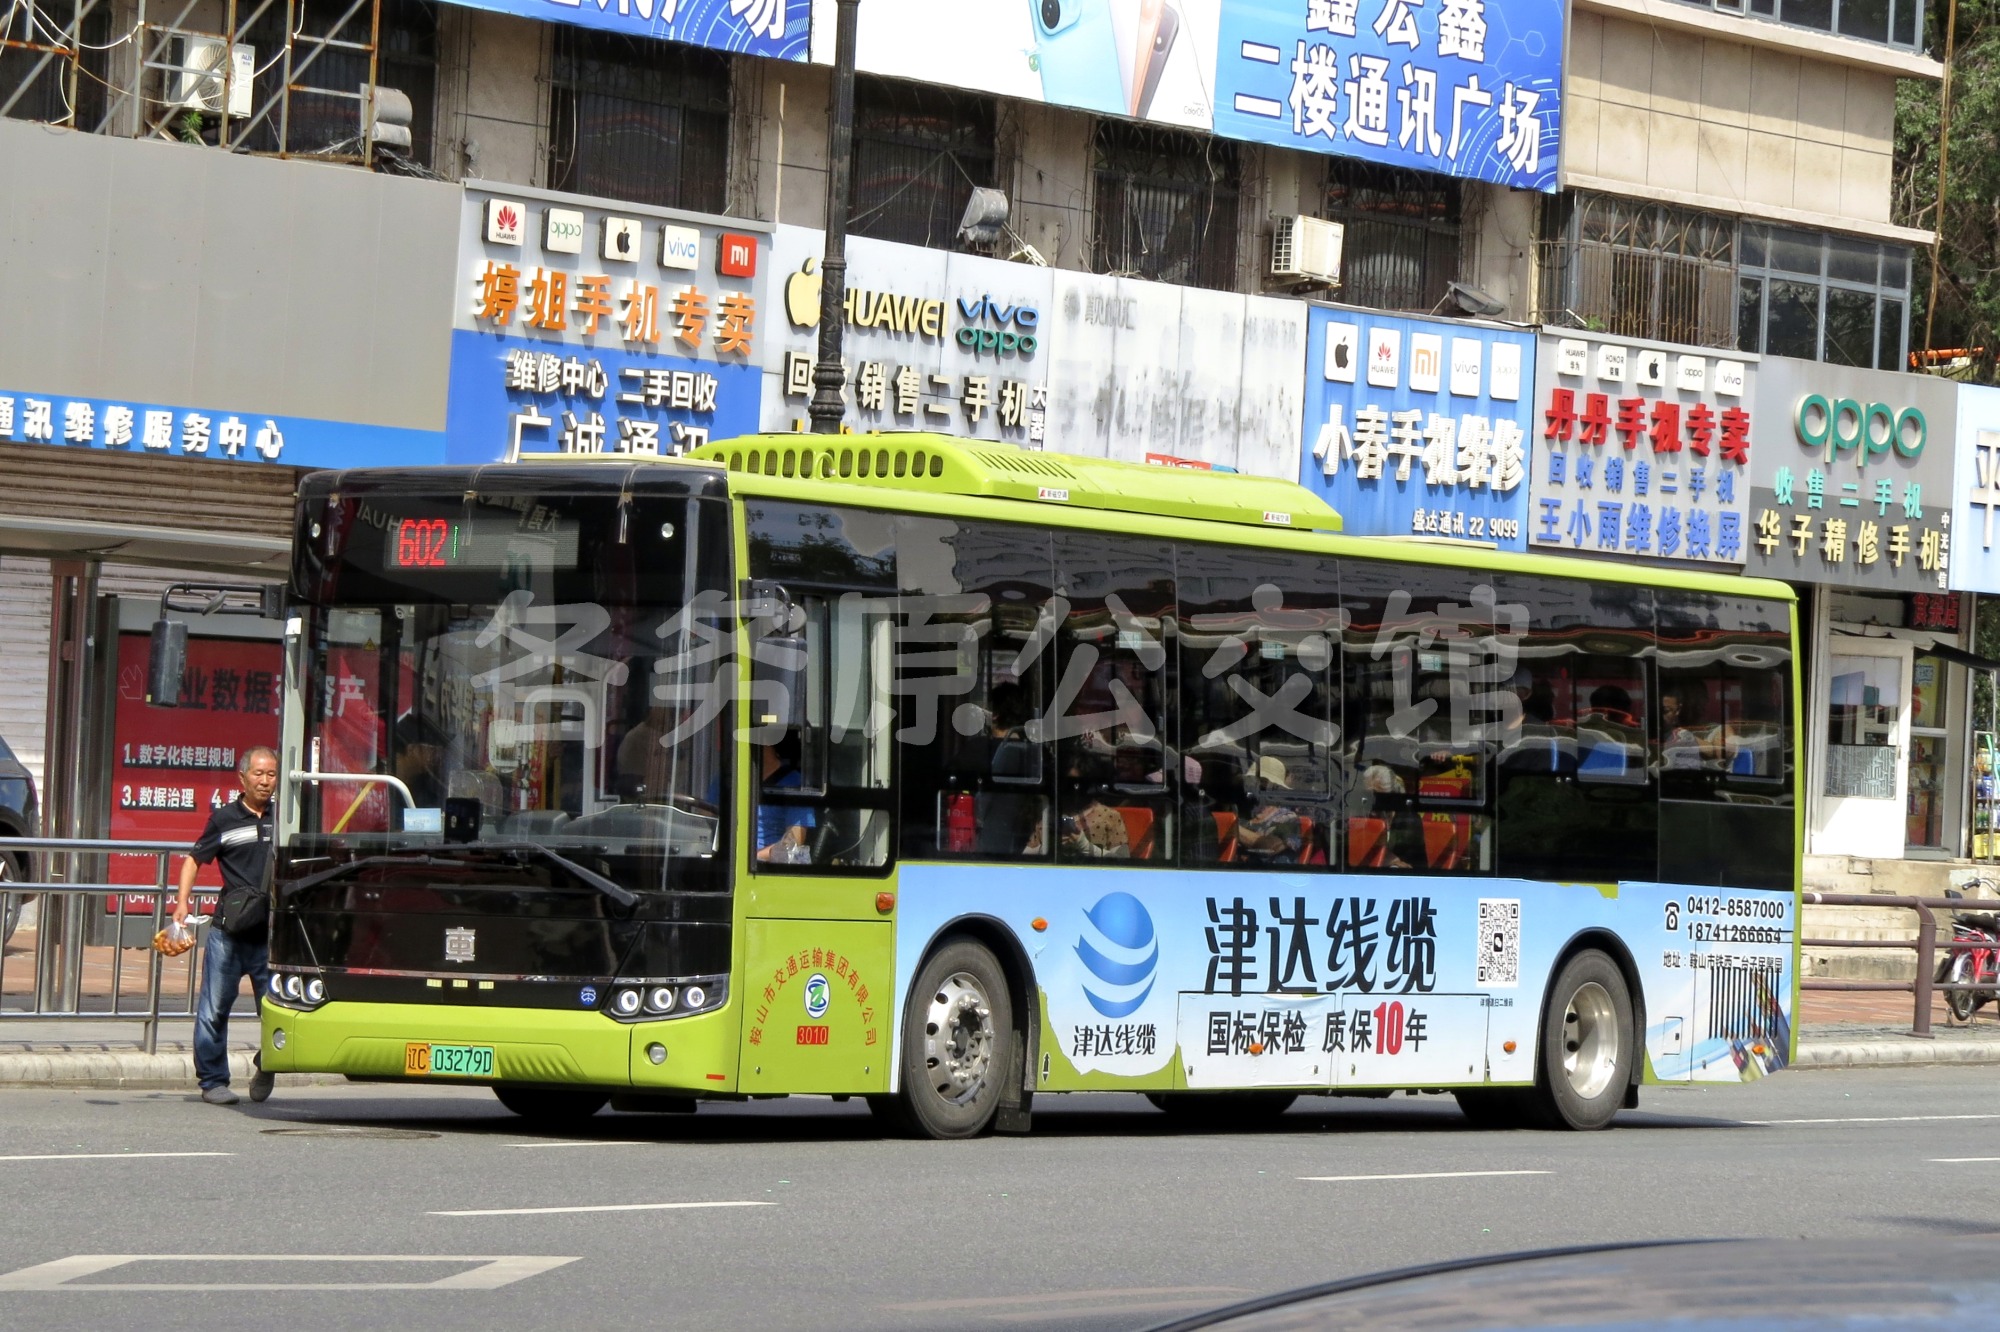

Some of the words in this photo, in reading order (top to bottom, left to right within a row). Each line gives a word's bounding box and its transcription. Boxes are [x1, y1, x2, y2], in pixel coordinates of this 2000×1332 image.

[1234, 39, 1541, 174] 二楼通讯广场
[495, 231, 517, 241] HUAWEI
[668, 237, 696, 258] vivo
[474, 260, 756, 356] 婷姐手机专卖
[957, 294, 1039, 327] vivo
[957, 327, 1038, 356] oppo
[1565, 349, 1586, 358] HUAWEI
[1605, 354, 1625, 364] HONOR
[508, 351, 609, 398] 维修中心
[617, 367, 718, 412] 二手回收
[1371, 365, 1396, 375] HUAWEI
[1455, 363, 1479, 375] vivo
[1723, 374, 1742, 385] vivo
[1545, 388, 1750, 465] 丹丹手机专卖
[1795, 394, 1927, 467] oppo
[1313, 404, 1525, 491] 小春手机维修
[1548, 452, 1735, 504] 回收销售二手机
[1774, 466, 1923, 519] 收售二手机
[398, 519, 449, 567] 602
[1413, 508, 1464, 535] 盛达通讯
[1469, 517, 1484, 536] 22
[1489, 518, 1519, 538] 9099
[1537, 498, 1741, 560] 王小雨维修换屏
[1755, 509, 1940, 571] 华子精修手机
[122, 784, 194, 808] 3.数据治理
[1687, 896, 1784, 919] 0412-8587000
[1204, 897, 1437, 997] 津达线缆
[749, 947, 877, 1046] 鞍山市交通运输集团有限公司
[798, 1026, 828, 1044] 3010
[1073, 1023, 1157, 1057] 津达线缆
[1207, 1010, 1307, 1056] 国标保检
[1322, 1001, 1427, 1055] 质保10年
